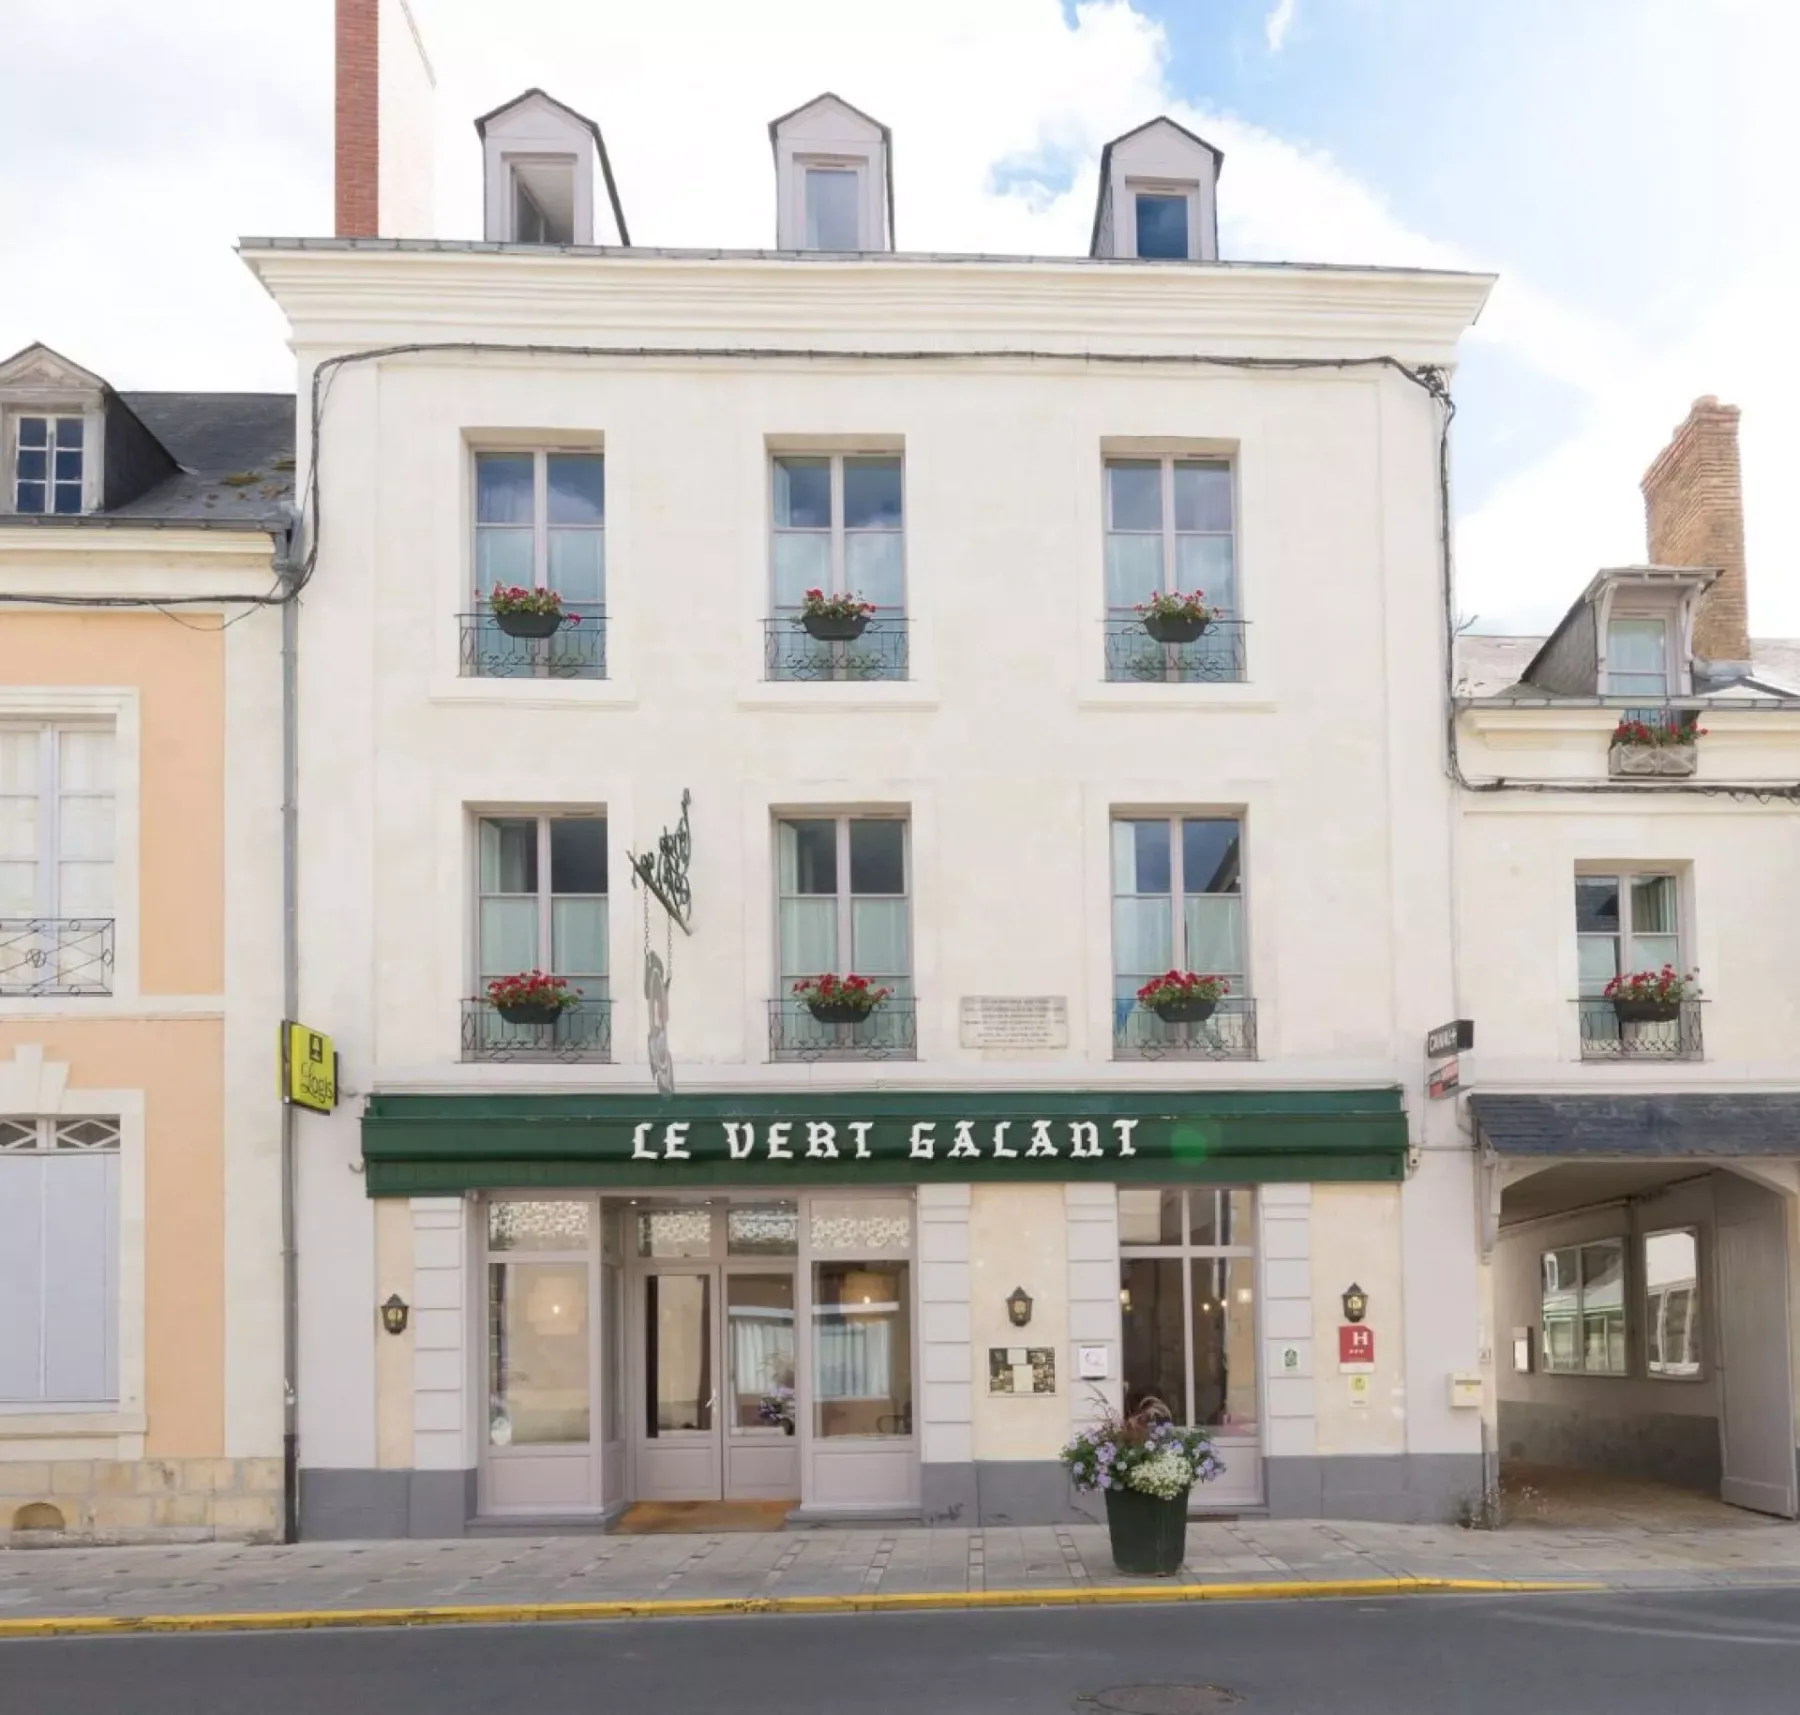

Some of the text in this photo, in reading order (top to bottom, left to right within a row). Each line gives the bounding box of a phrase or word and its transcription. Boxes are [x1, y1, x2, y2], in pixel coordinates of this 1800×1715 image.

[300, 1062, 333, 1104] Logis
[631, 1119, 1139, 1160] LE VERT GALANT
[1352, 1331, 1369, 1346] H
